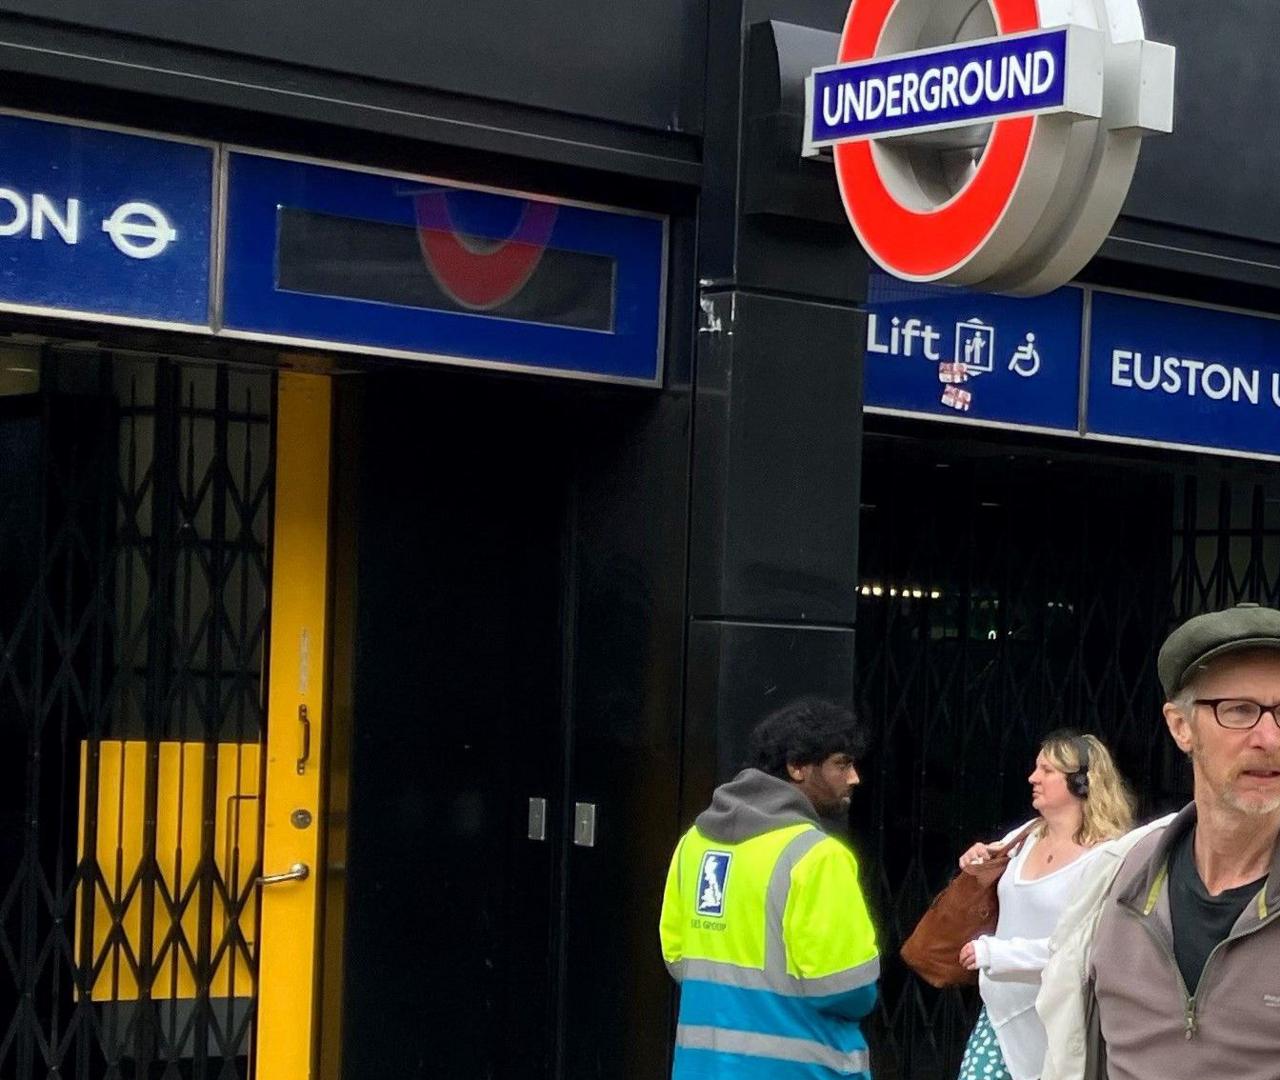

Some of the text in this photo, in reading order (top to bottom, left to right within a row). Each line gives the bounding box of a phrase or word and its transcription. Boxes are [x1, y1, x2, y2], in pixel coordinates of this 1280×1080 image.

[823, 51, 1055, 126] UNDERGROUND
[867, 313, 940, 361] Lift
[1111, 349, 1260, 405] EUSTON
